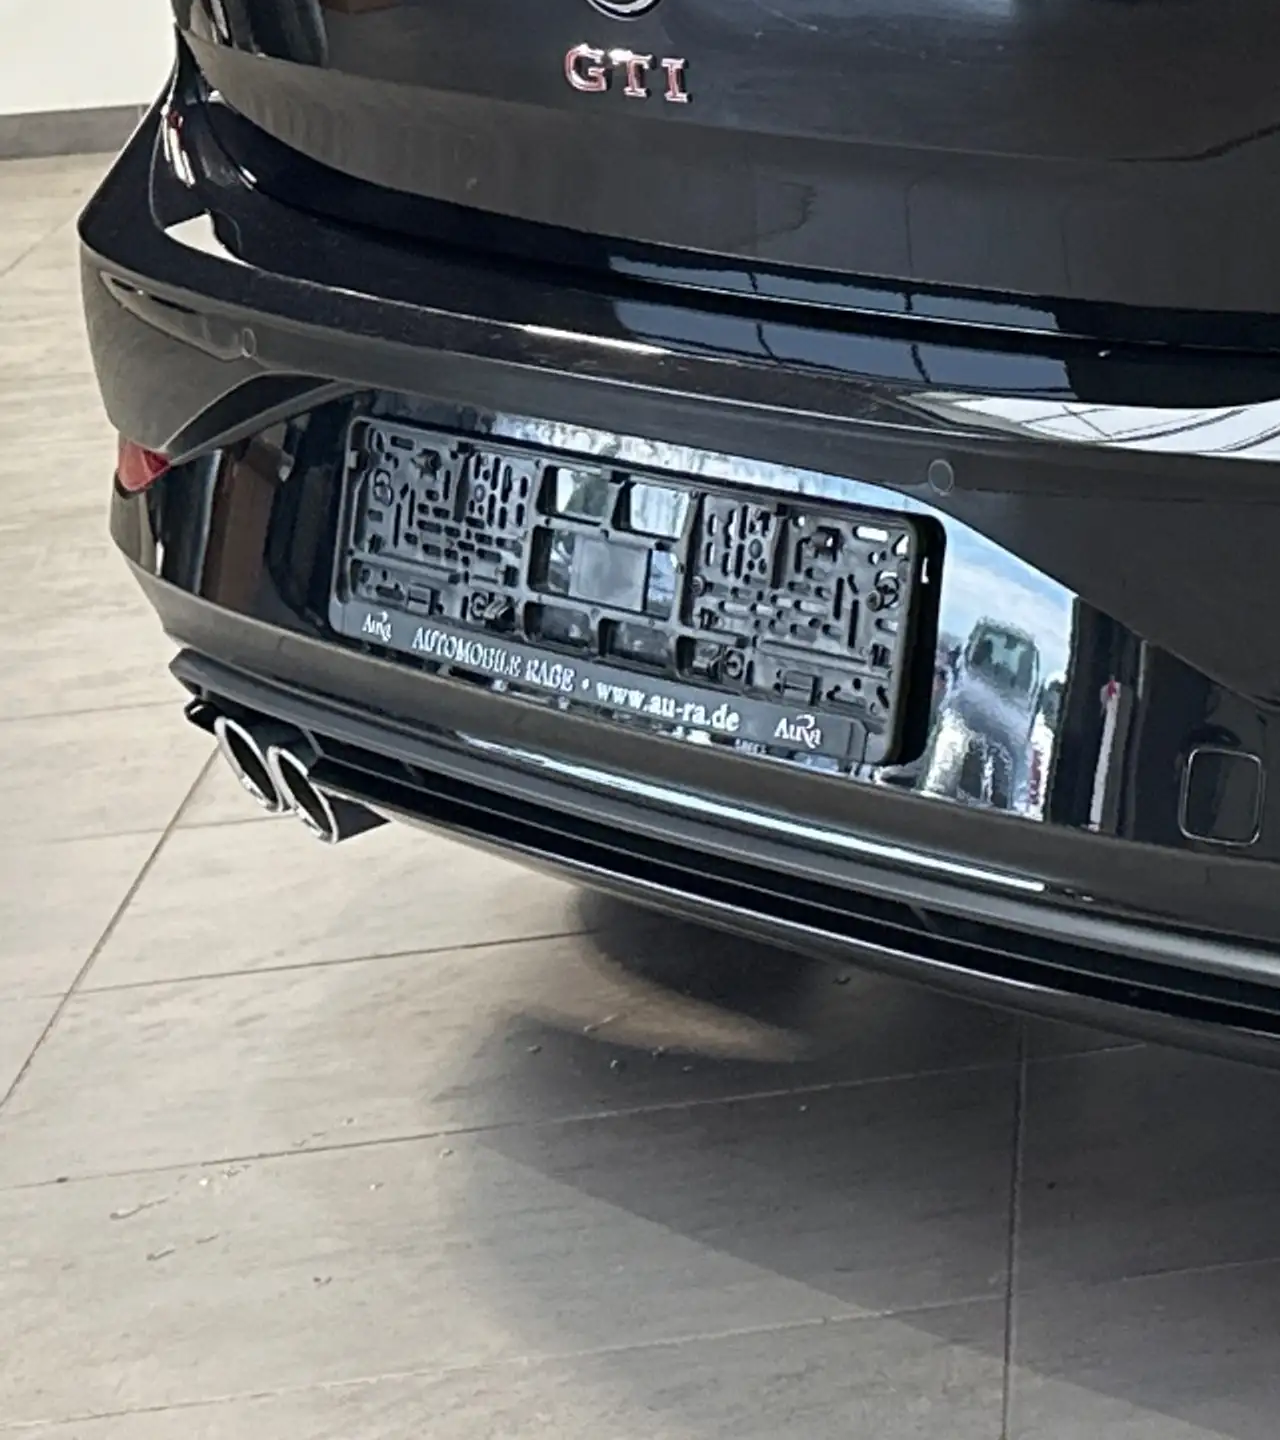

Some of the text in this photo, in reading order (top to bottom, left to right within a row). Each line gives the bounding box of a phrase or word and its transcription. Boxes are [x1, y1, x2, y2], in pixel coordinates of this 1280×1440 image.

[565, 44, 689, 102] GTI
[412, 627, 522, 677] AUTOMOBILE
[596, 681, 740, 732] www.au-ra.de
[774, 714, 822, 749] AuRa
